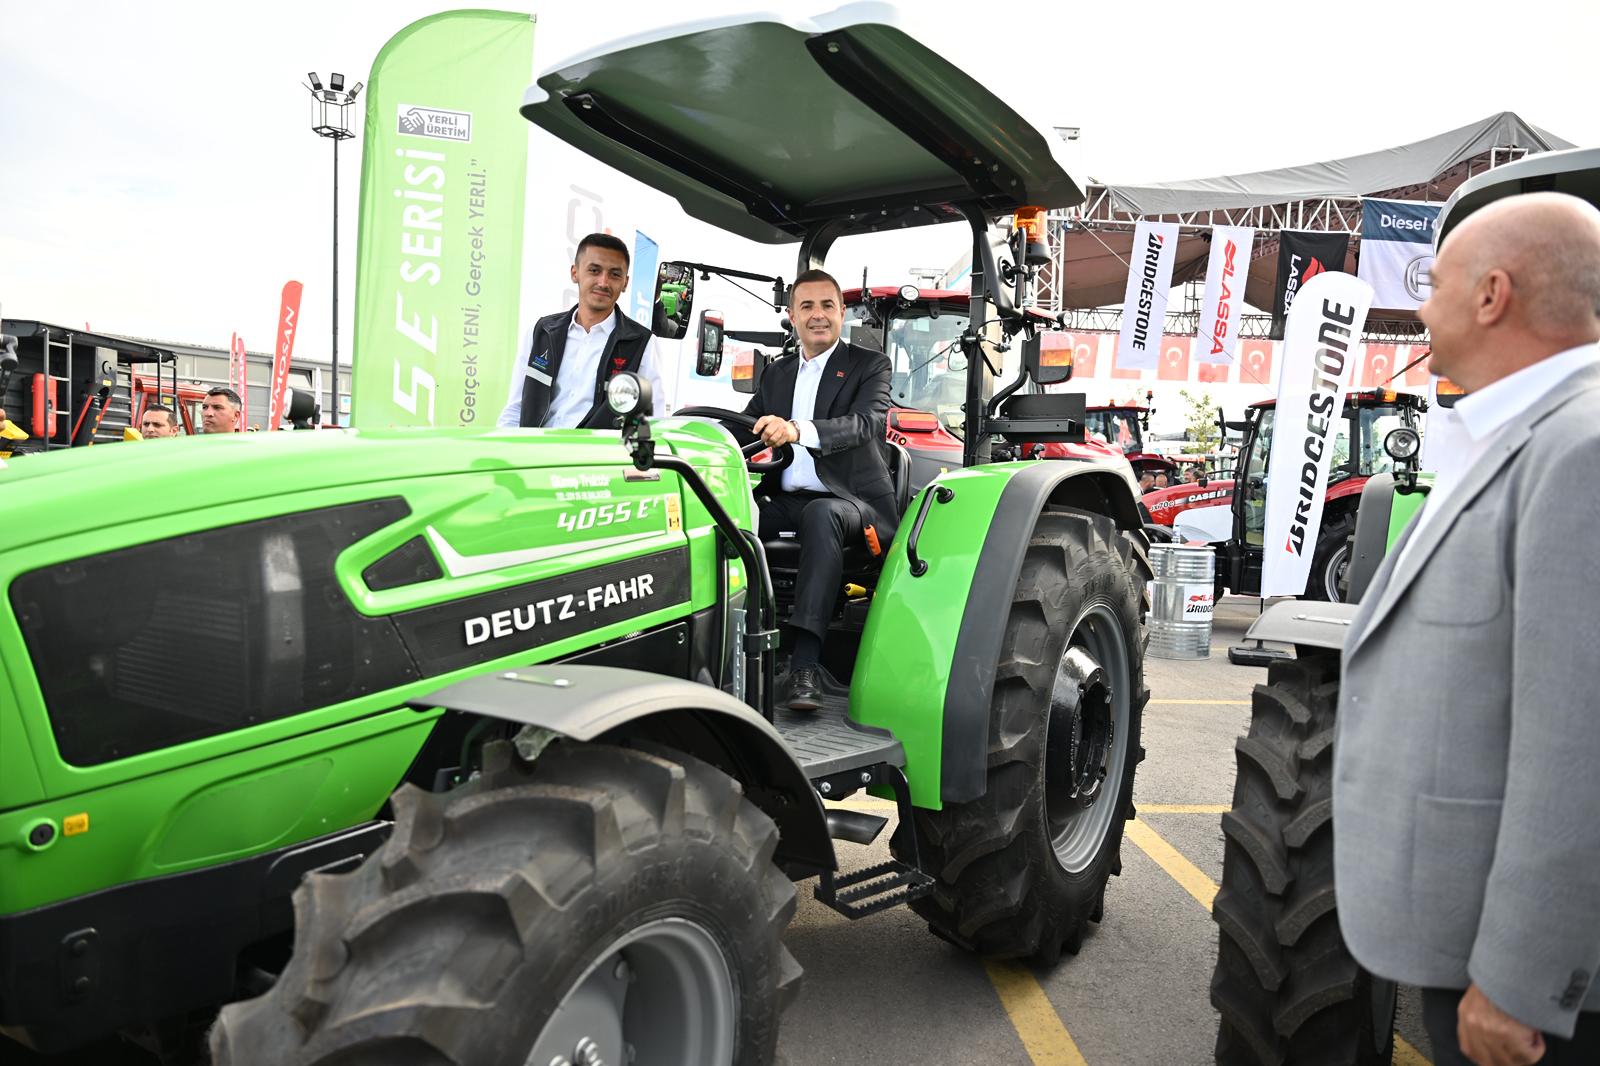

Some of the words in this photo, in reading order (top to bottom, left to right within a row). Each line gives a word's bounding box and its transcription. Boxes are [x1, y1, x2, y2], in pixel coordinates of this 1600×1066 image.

[426, 123, 466, 137] ÜRETİM
[428, 114, 458, 126] YERLİ
[393, 147, 447, 287] SERİSİ
[1380, 213, 1428, 231] Diesel
[465, 226, 486, 297] Gerçek
[1132, 231, 1164, 351] BRIDGESTONE
[1282, 253, 1302, 317] LASSA
[1210, 265, 1236, 355] LASSA
[1286, 298, 1355, 558] BRIDGESTONE
[557, 501, 632, 533] 4055
[1188, 492, 1216, 503] CASE
[464, 573, 654, 647] DEUTZ-FAHR
